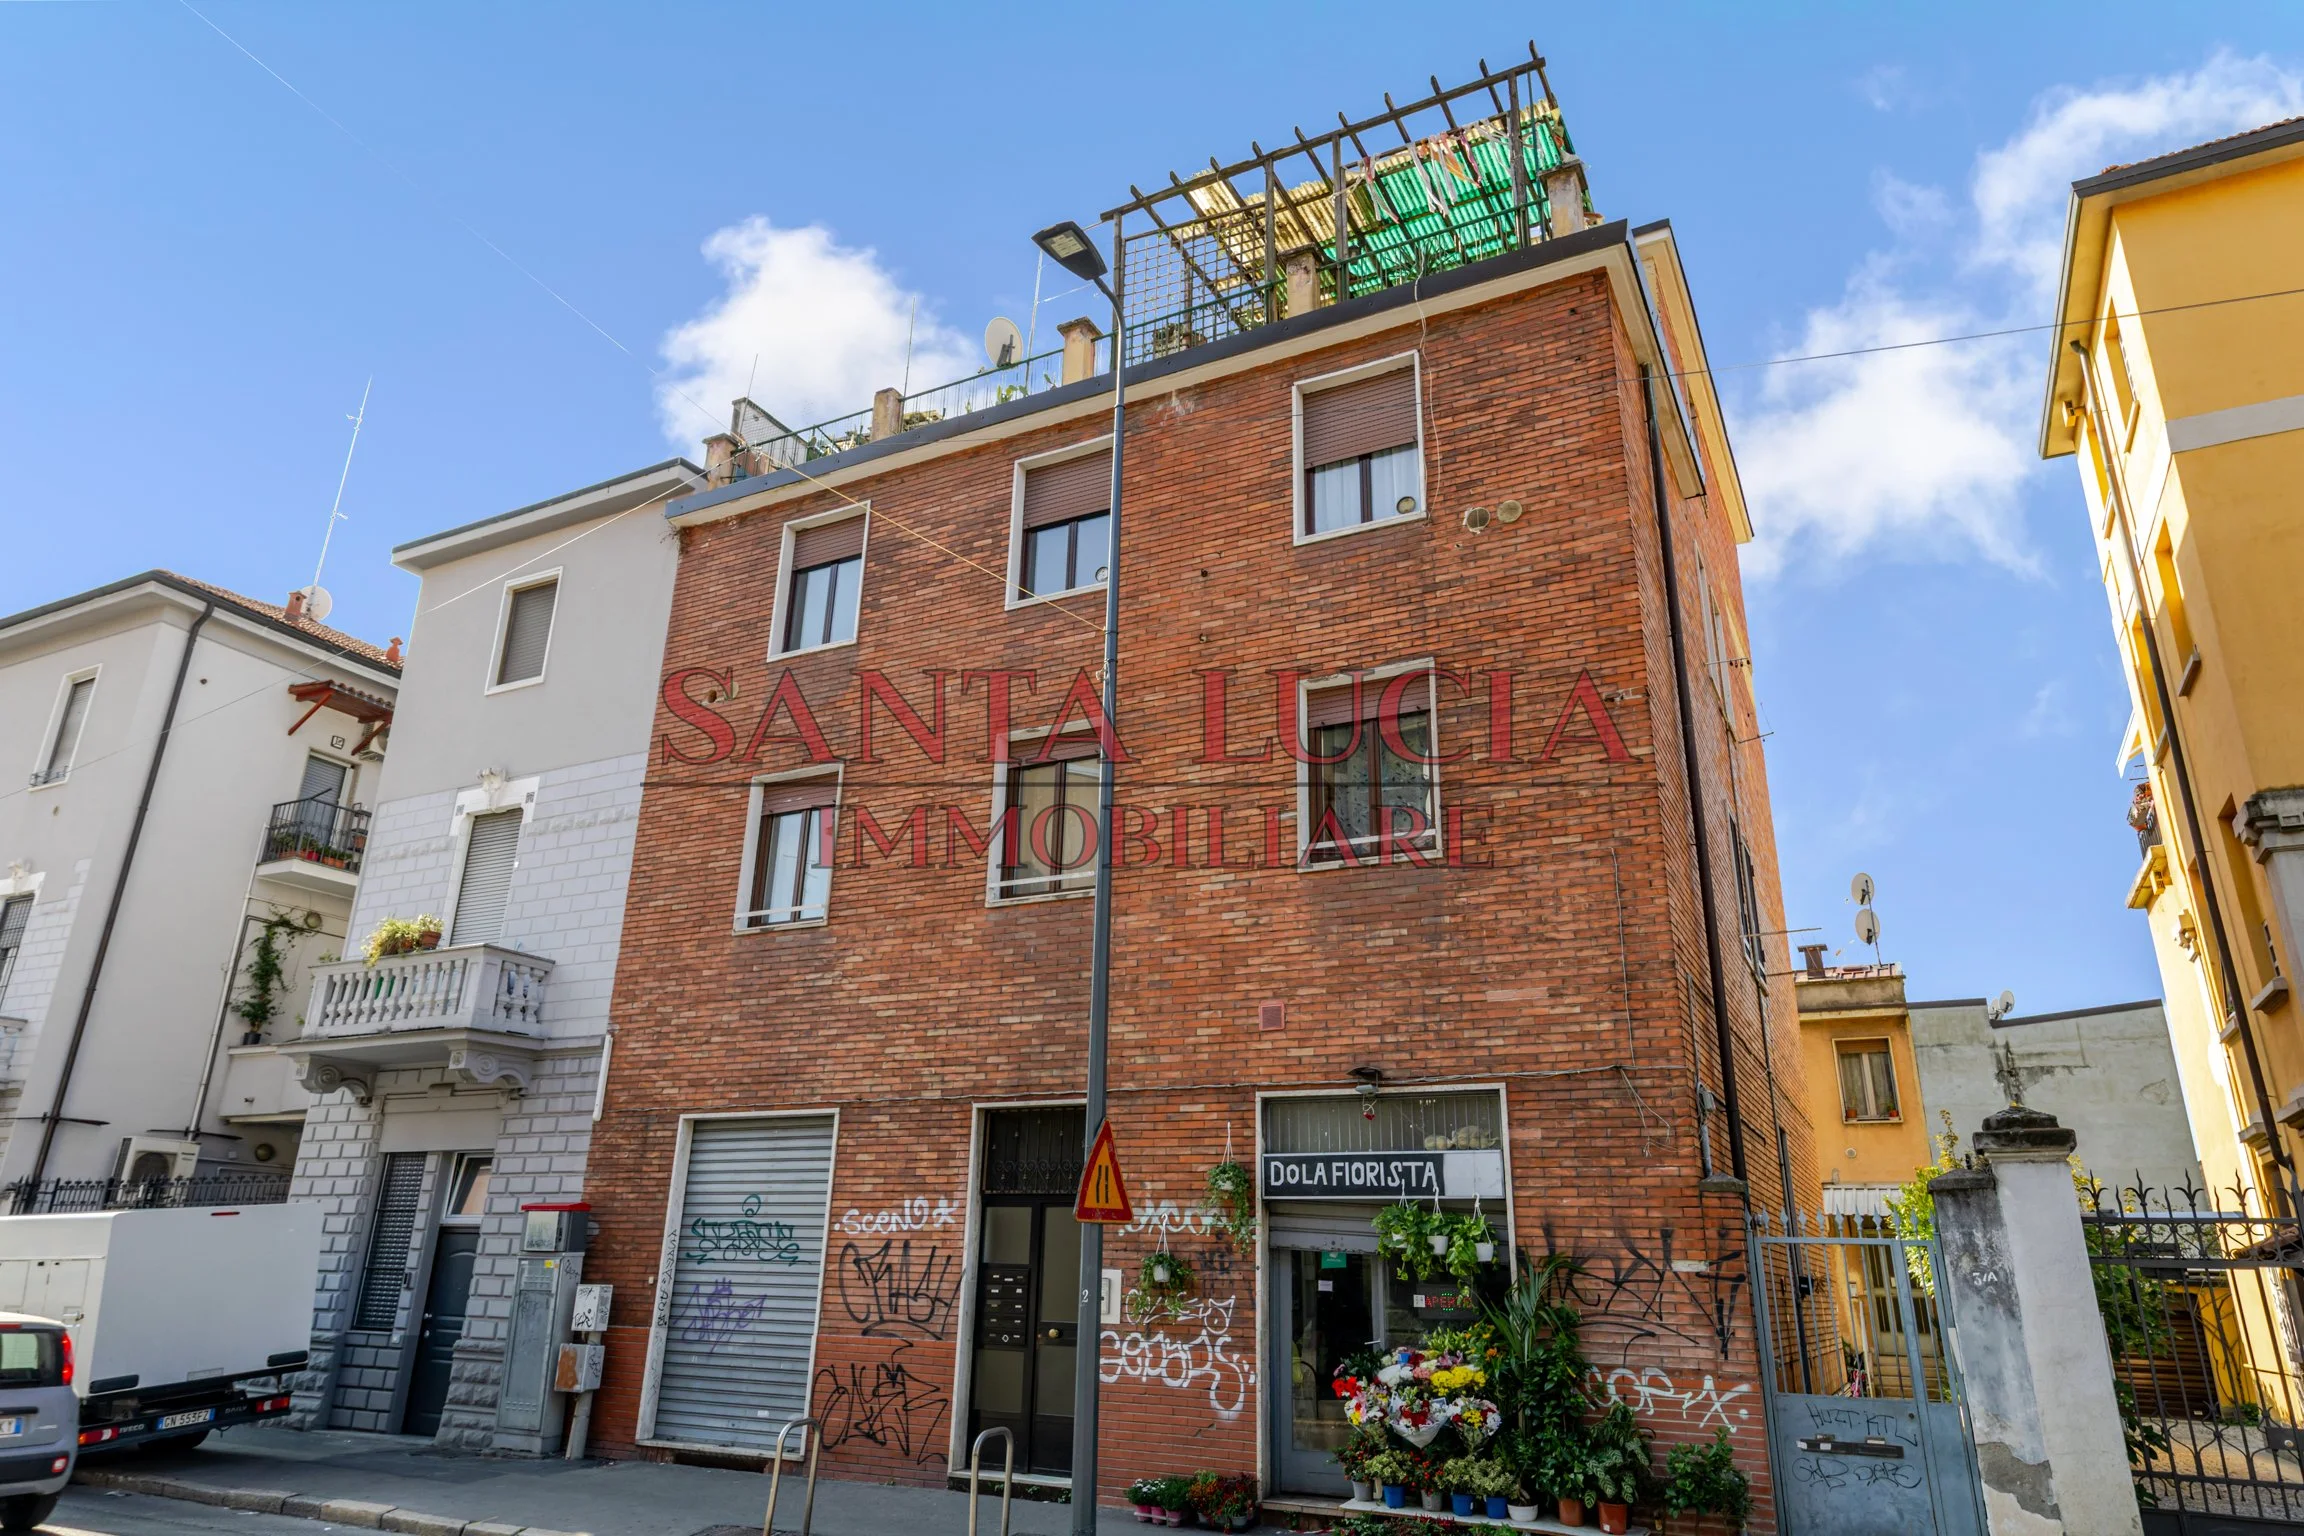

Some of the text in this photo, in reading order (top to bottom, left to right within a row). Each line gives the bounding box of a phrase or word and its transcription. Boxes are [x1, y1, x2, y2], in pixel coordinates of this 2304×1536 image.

[1973, 1271, 1998, 1286] 3/A
[224, 1405, 248, 1414] DAILY
[119, 1424, 145, 1433] IVECO
